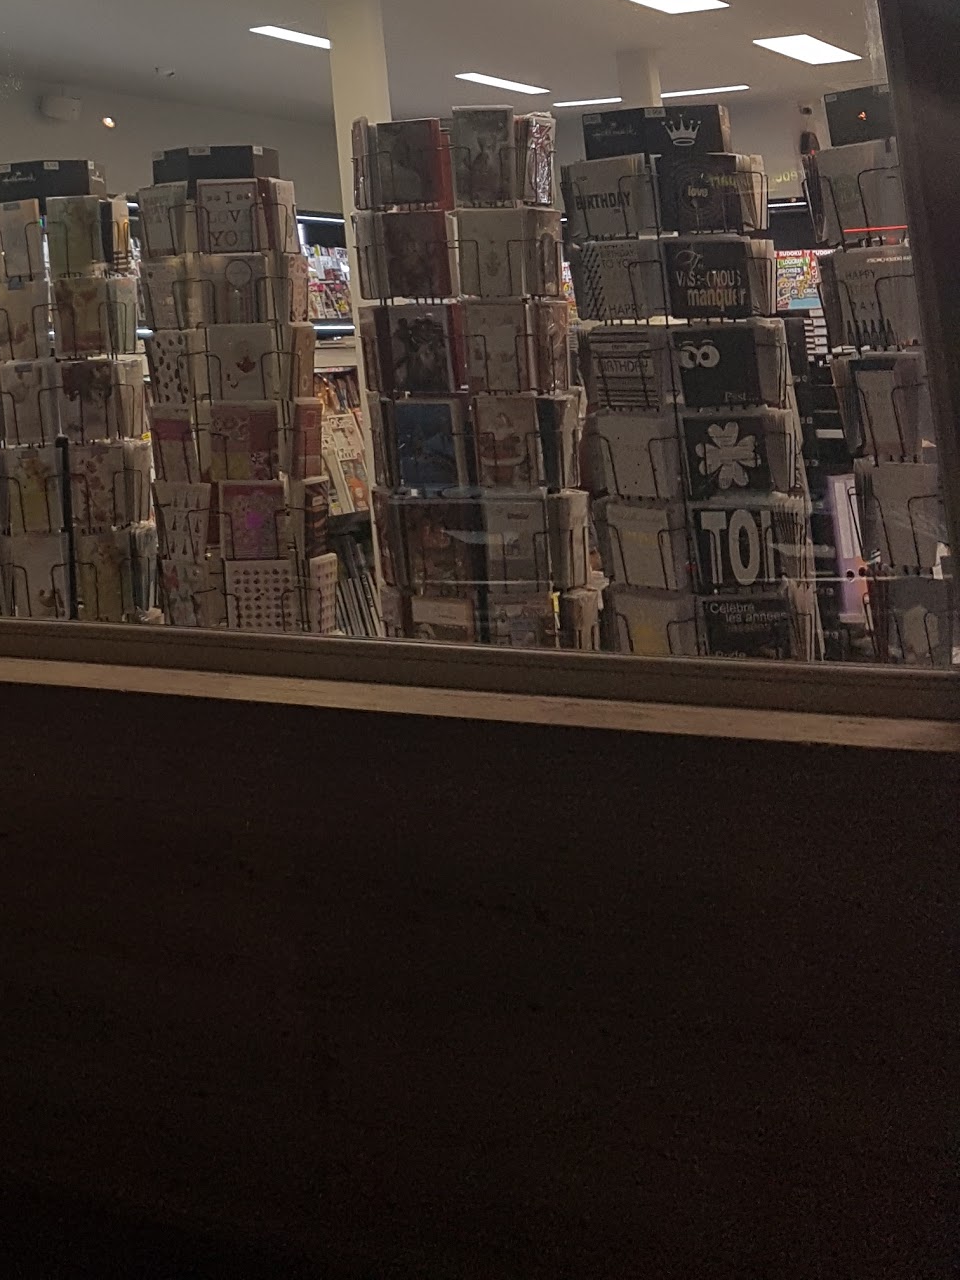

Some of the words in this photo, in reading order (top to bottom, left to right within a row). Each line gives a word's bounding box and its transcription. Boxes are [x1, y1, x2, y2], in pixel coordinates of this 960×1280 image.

[226, 190, 233, 205] I
[687, 185, 709, 198] love
[575, 191, 632, 211] BIRTHDAY
